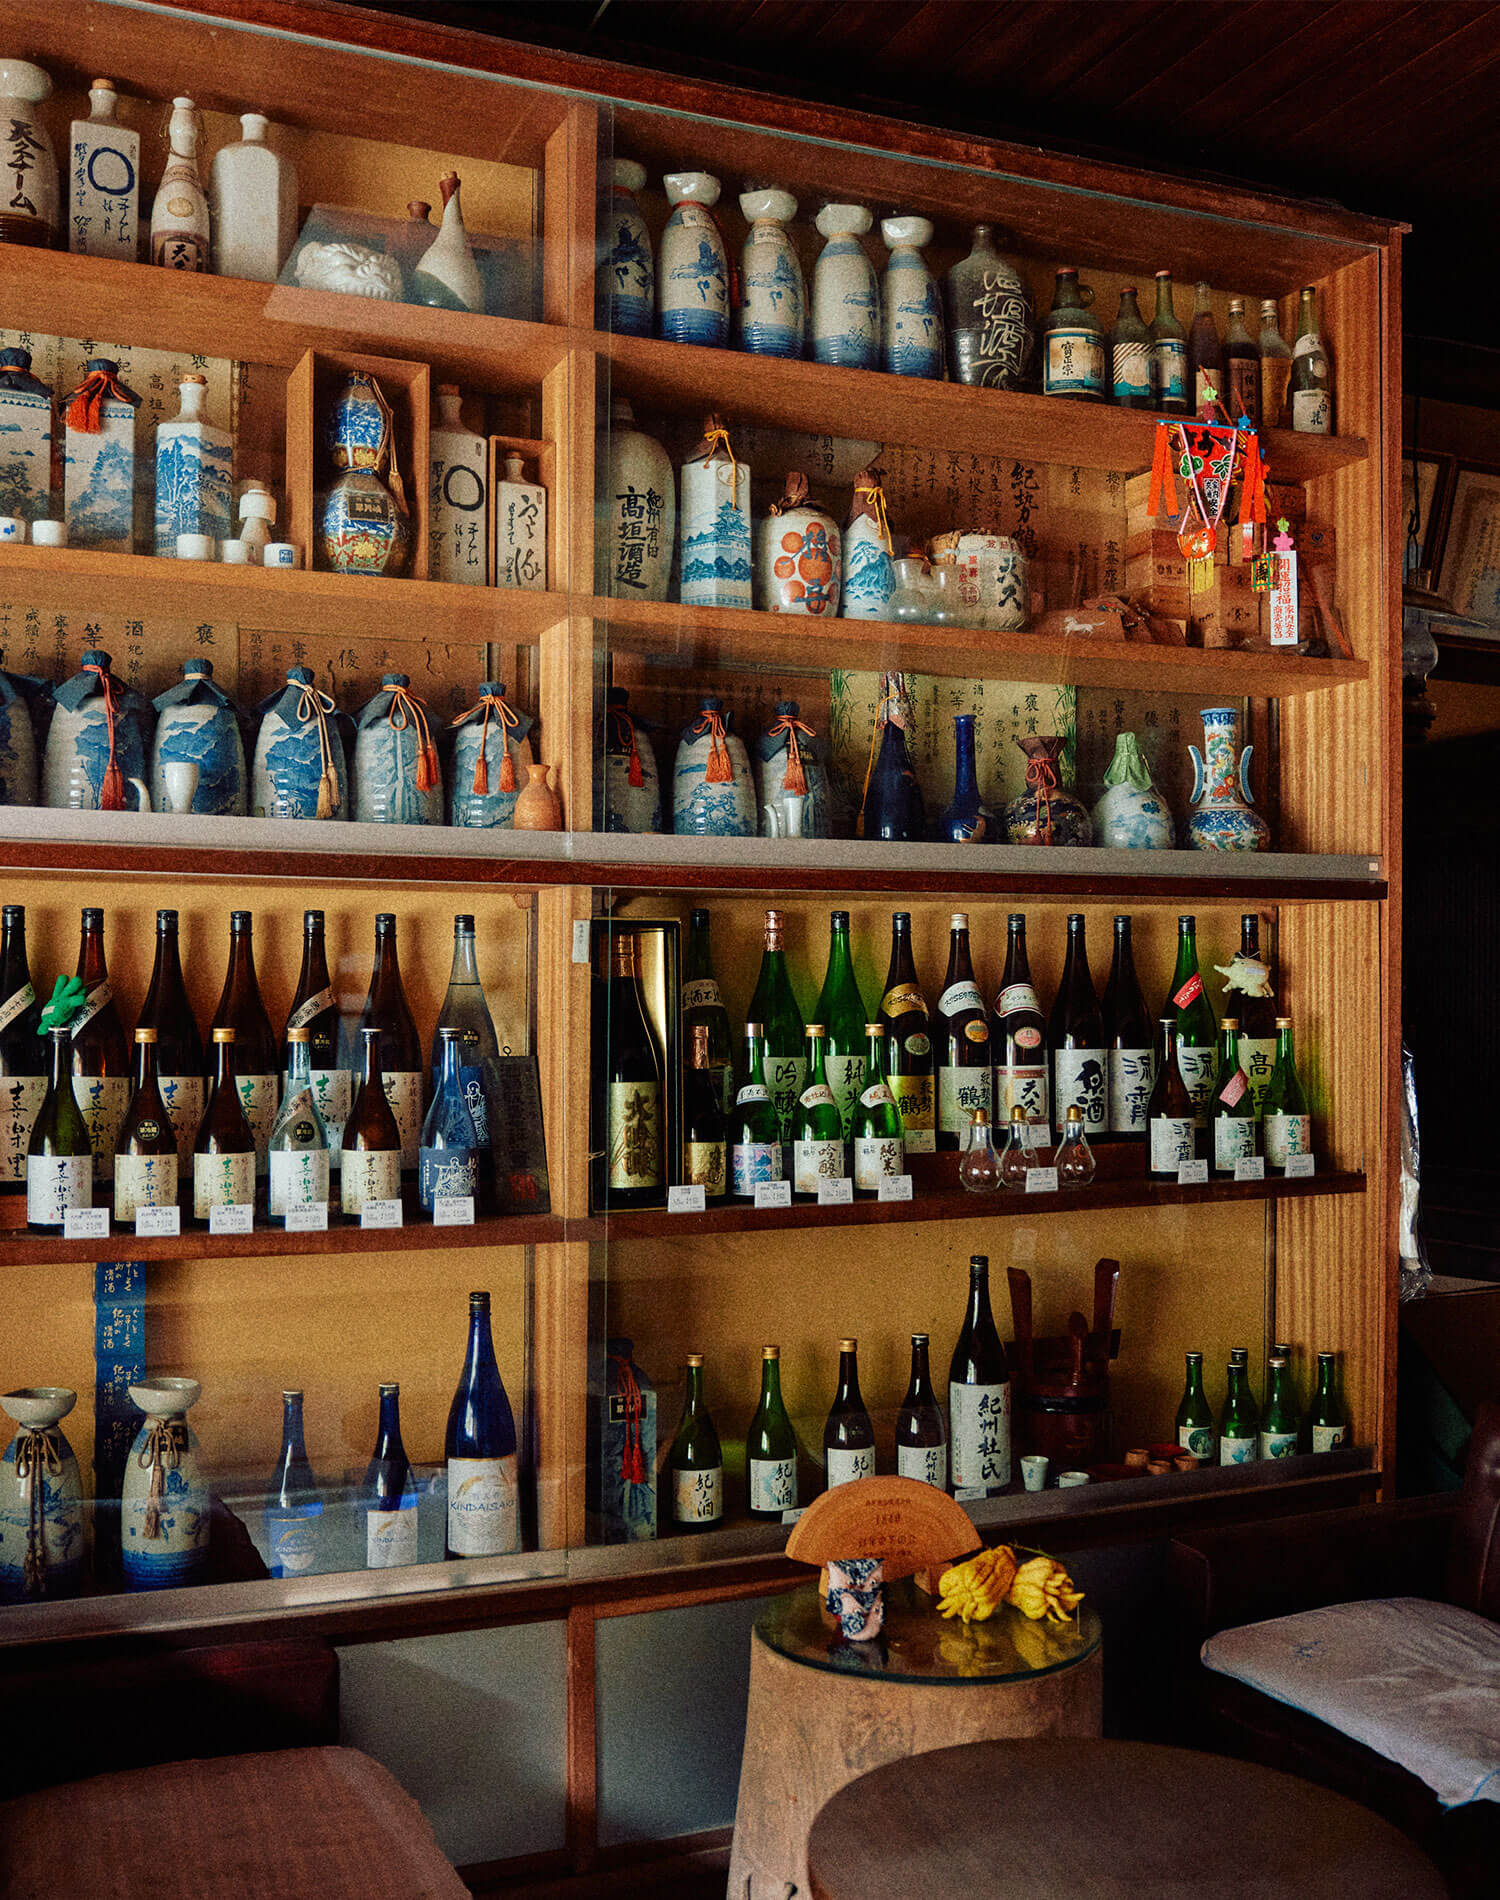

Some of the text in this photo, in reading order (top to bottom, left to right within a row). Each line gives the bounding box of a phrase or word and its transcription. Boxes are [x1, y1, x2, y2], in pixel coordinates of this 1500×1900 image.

[616, 486, 648, 589] 高垣酒造
[646, 488, 664, 558] 紀州有田
[81, 623, 104, 648] 等
[898, 1094, 921, 1116] 鶴
[957, 1087, 982, 1107] 鶴
[818, 1144, 838, 1178] 吟醸
[978, 1394, 1001, 1480] 紀州杜氏
[776, 1463, 792, 1506] 紀ノ酒
[925, 1451, 937, 1486] 紀州杜
[695, 1474, 714, 1518] 紀ノ酒
